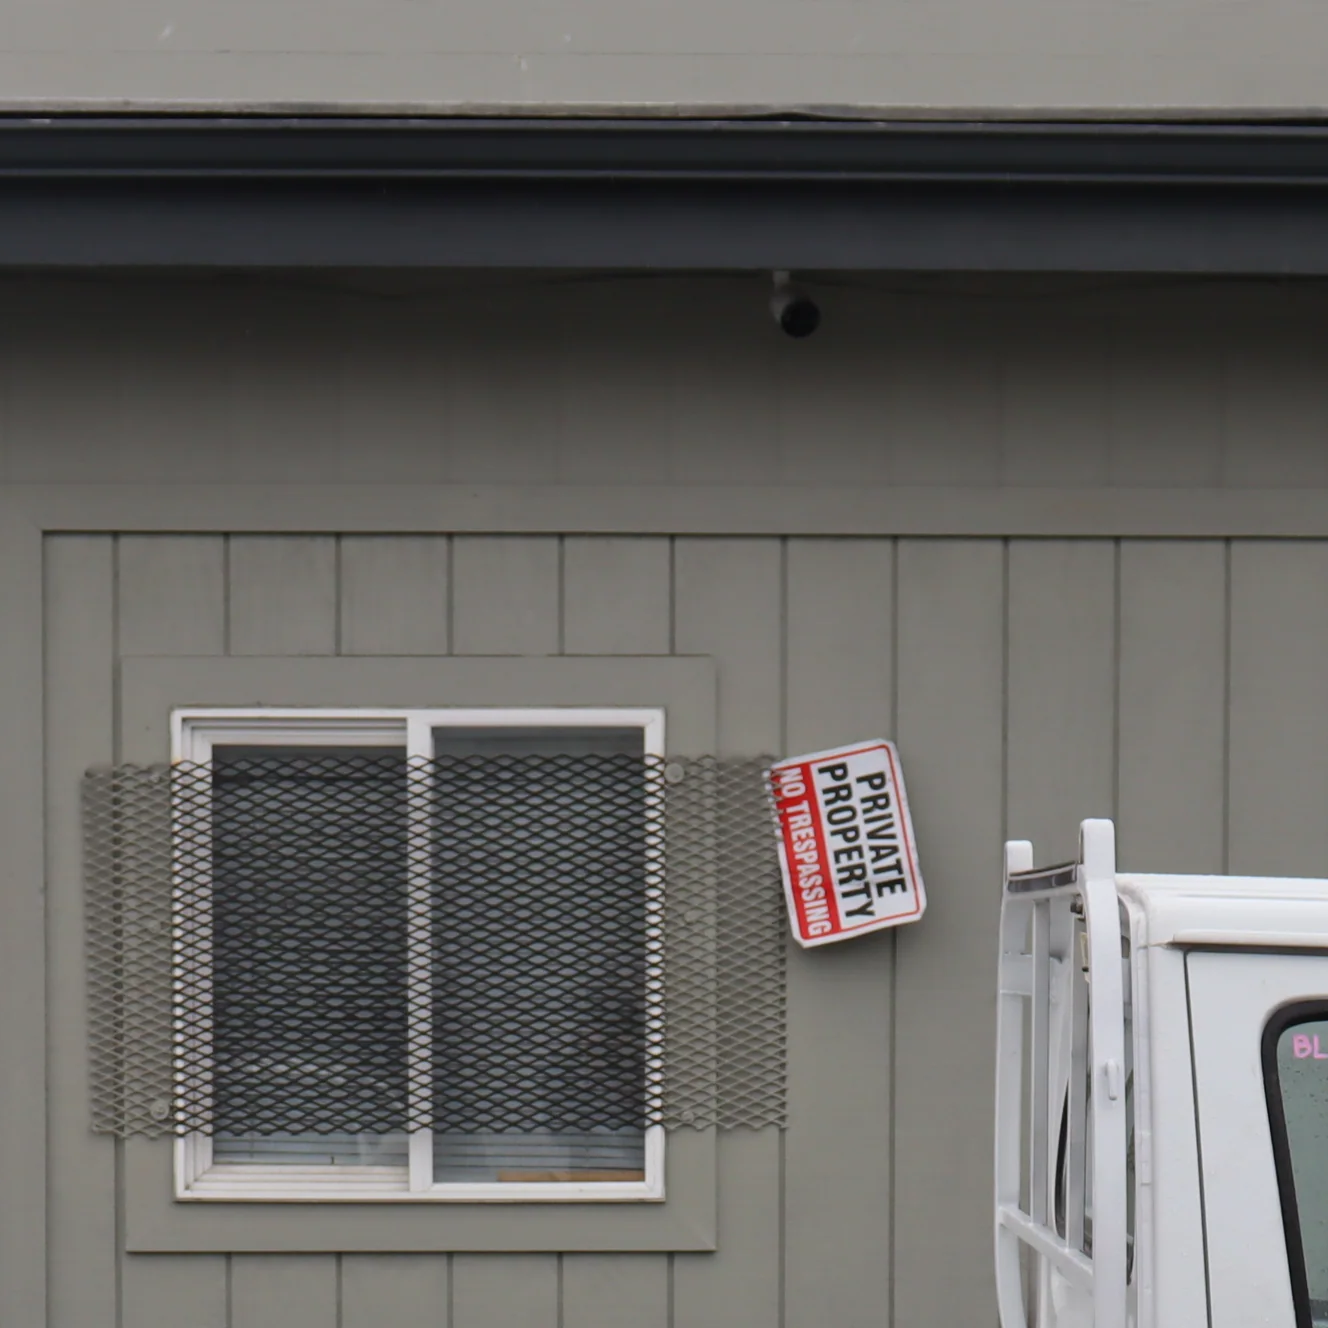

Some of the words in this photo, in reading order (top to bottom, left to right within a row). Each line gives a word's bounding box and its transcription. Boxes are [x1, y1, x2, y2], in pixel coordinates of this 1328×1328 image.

[779, 767, 806, 798] NO
[818, 762, 876, 918] PROPERTY
[856, 771, 907, 898] PRIVATE
[786, 801, 833, 936] TRESPASSING
